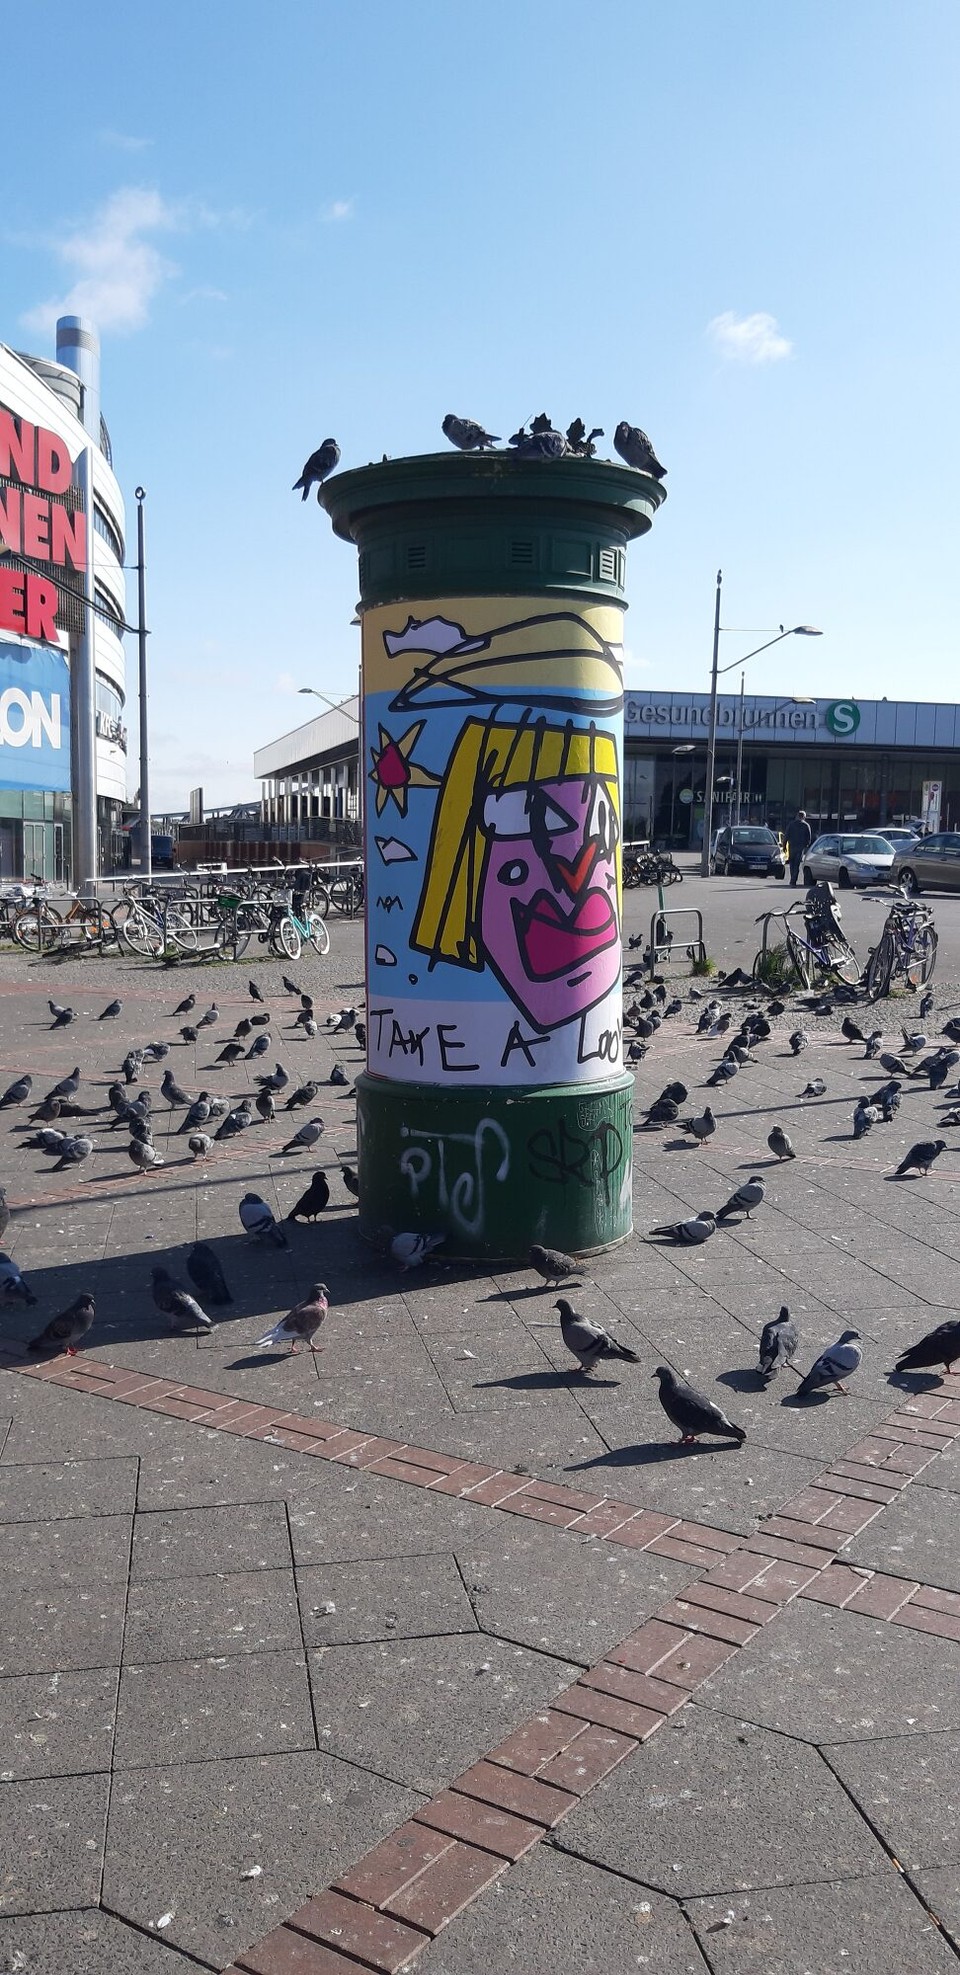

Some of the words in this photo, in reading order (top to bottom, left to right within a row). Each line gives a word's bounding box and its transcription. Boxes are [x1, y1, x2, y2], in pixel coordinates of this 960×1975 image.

[0, 409, 72, 494] ND
[0, 565, 60, 642] ER
[0, 687, 60, 749] ON
[624, 700, 820, 729] Gesundbrunnen
[833, 704, 855, 733] S
[370, 1008, 479, 1071] TAKE
[501, 1020, 550, 1067] A
